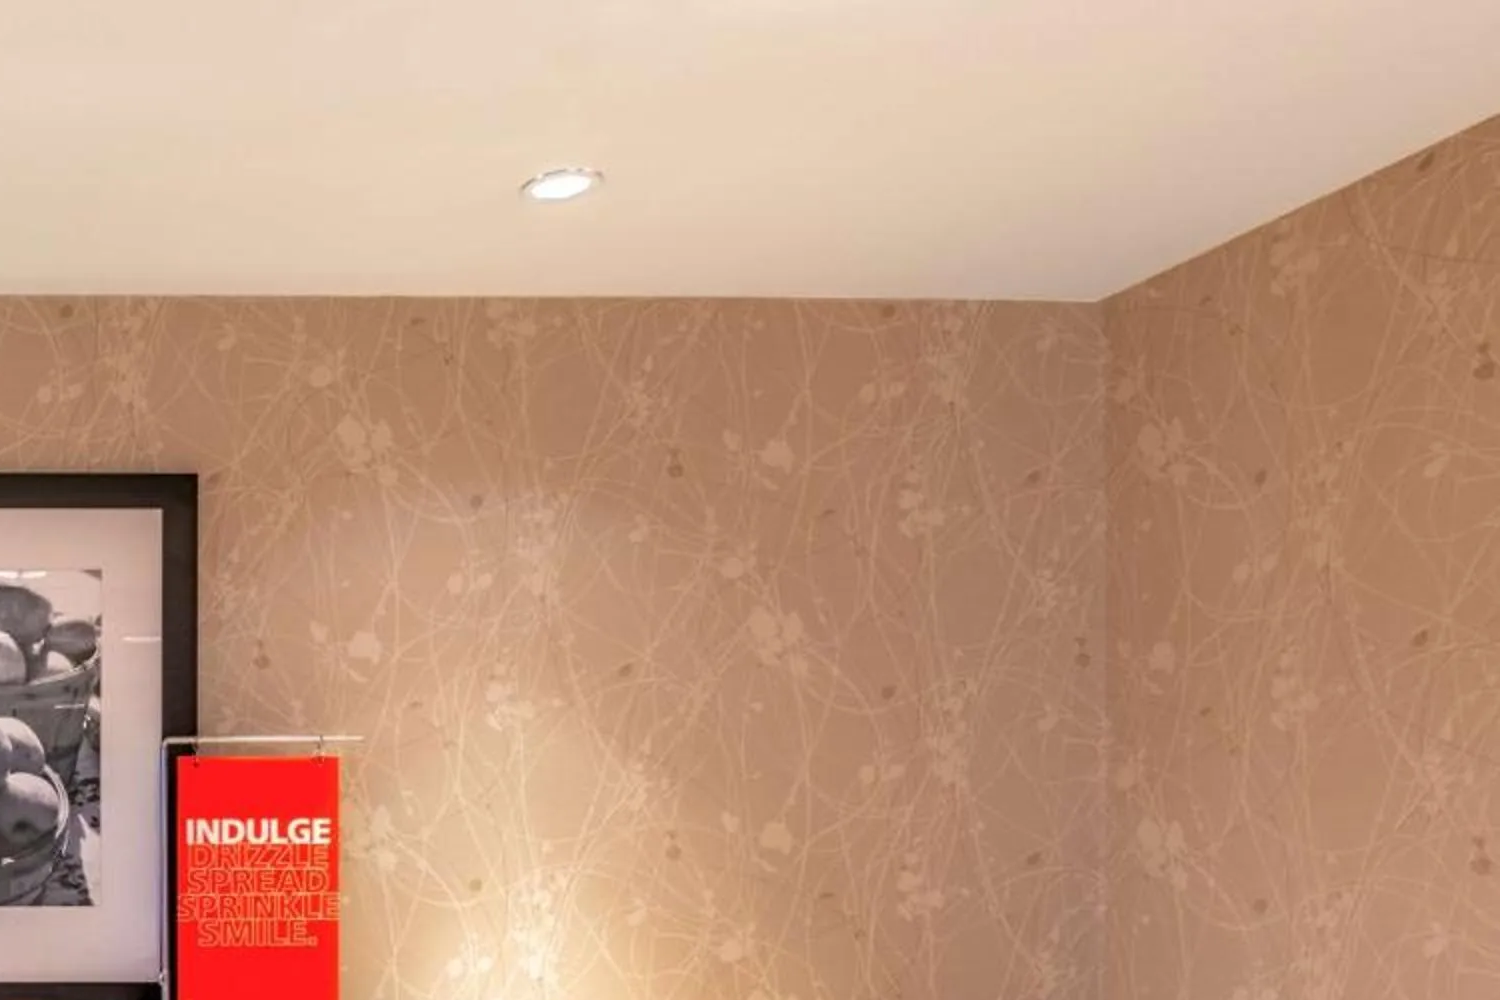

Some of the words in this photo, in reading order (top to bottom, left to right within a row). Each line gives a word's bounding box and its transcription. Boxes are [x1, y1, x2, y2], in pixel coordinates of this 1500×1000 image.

[185, 817, 332, 846] INDULGE
[190, 843, 330, 870] DRIZZLE
[187, 867, 329, 894] SPREAD
[177, 891, 341, 922] SPRINKLE
[197, 918, 319, 947] SMILE.
